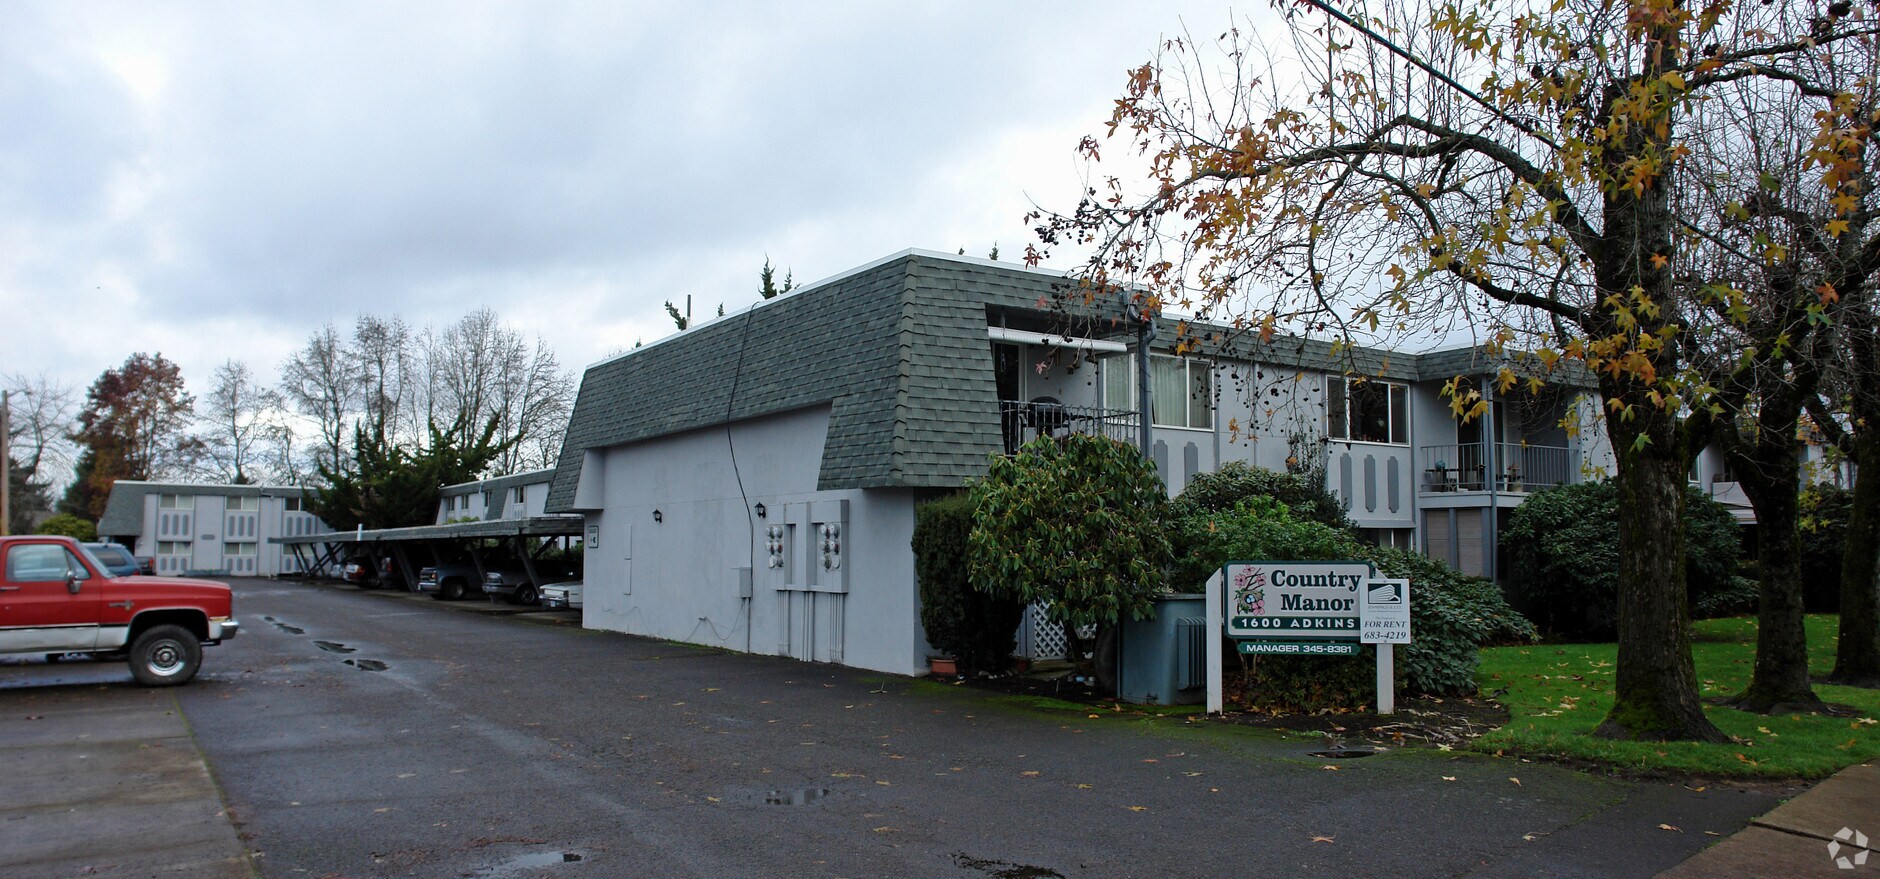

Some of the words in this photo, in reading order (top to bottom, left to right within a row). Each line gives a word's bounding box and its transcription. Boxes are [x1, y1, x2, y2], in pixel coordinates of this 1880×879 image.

[1271, 569, 1362, 591] Country
[1280, 594, 1355, 611] Manor
[1241, 618, 1282, 628] 1600
[1290, 618, 1356, 628] ADKINS
[1364, 620, 1382, 628] FOR
[1383, 620, 1407, 628] RENT
[1364, 631, 1407, 640] 683-4219
[1246, 644, 1300, 653] MANAGER
[1302, 645, 1353, 653] 345-8381
